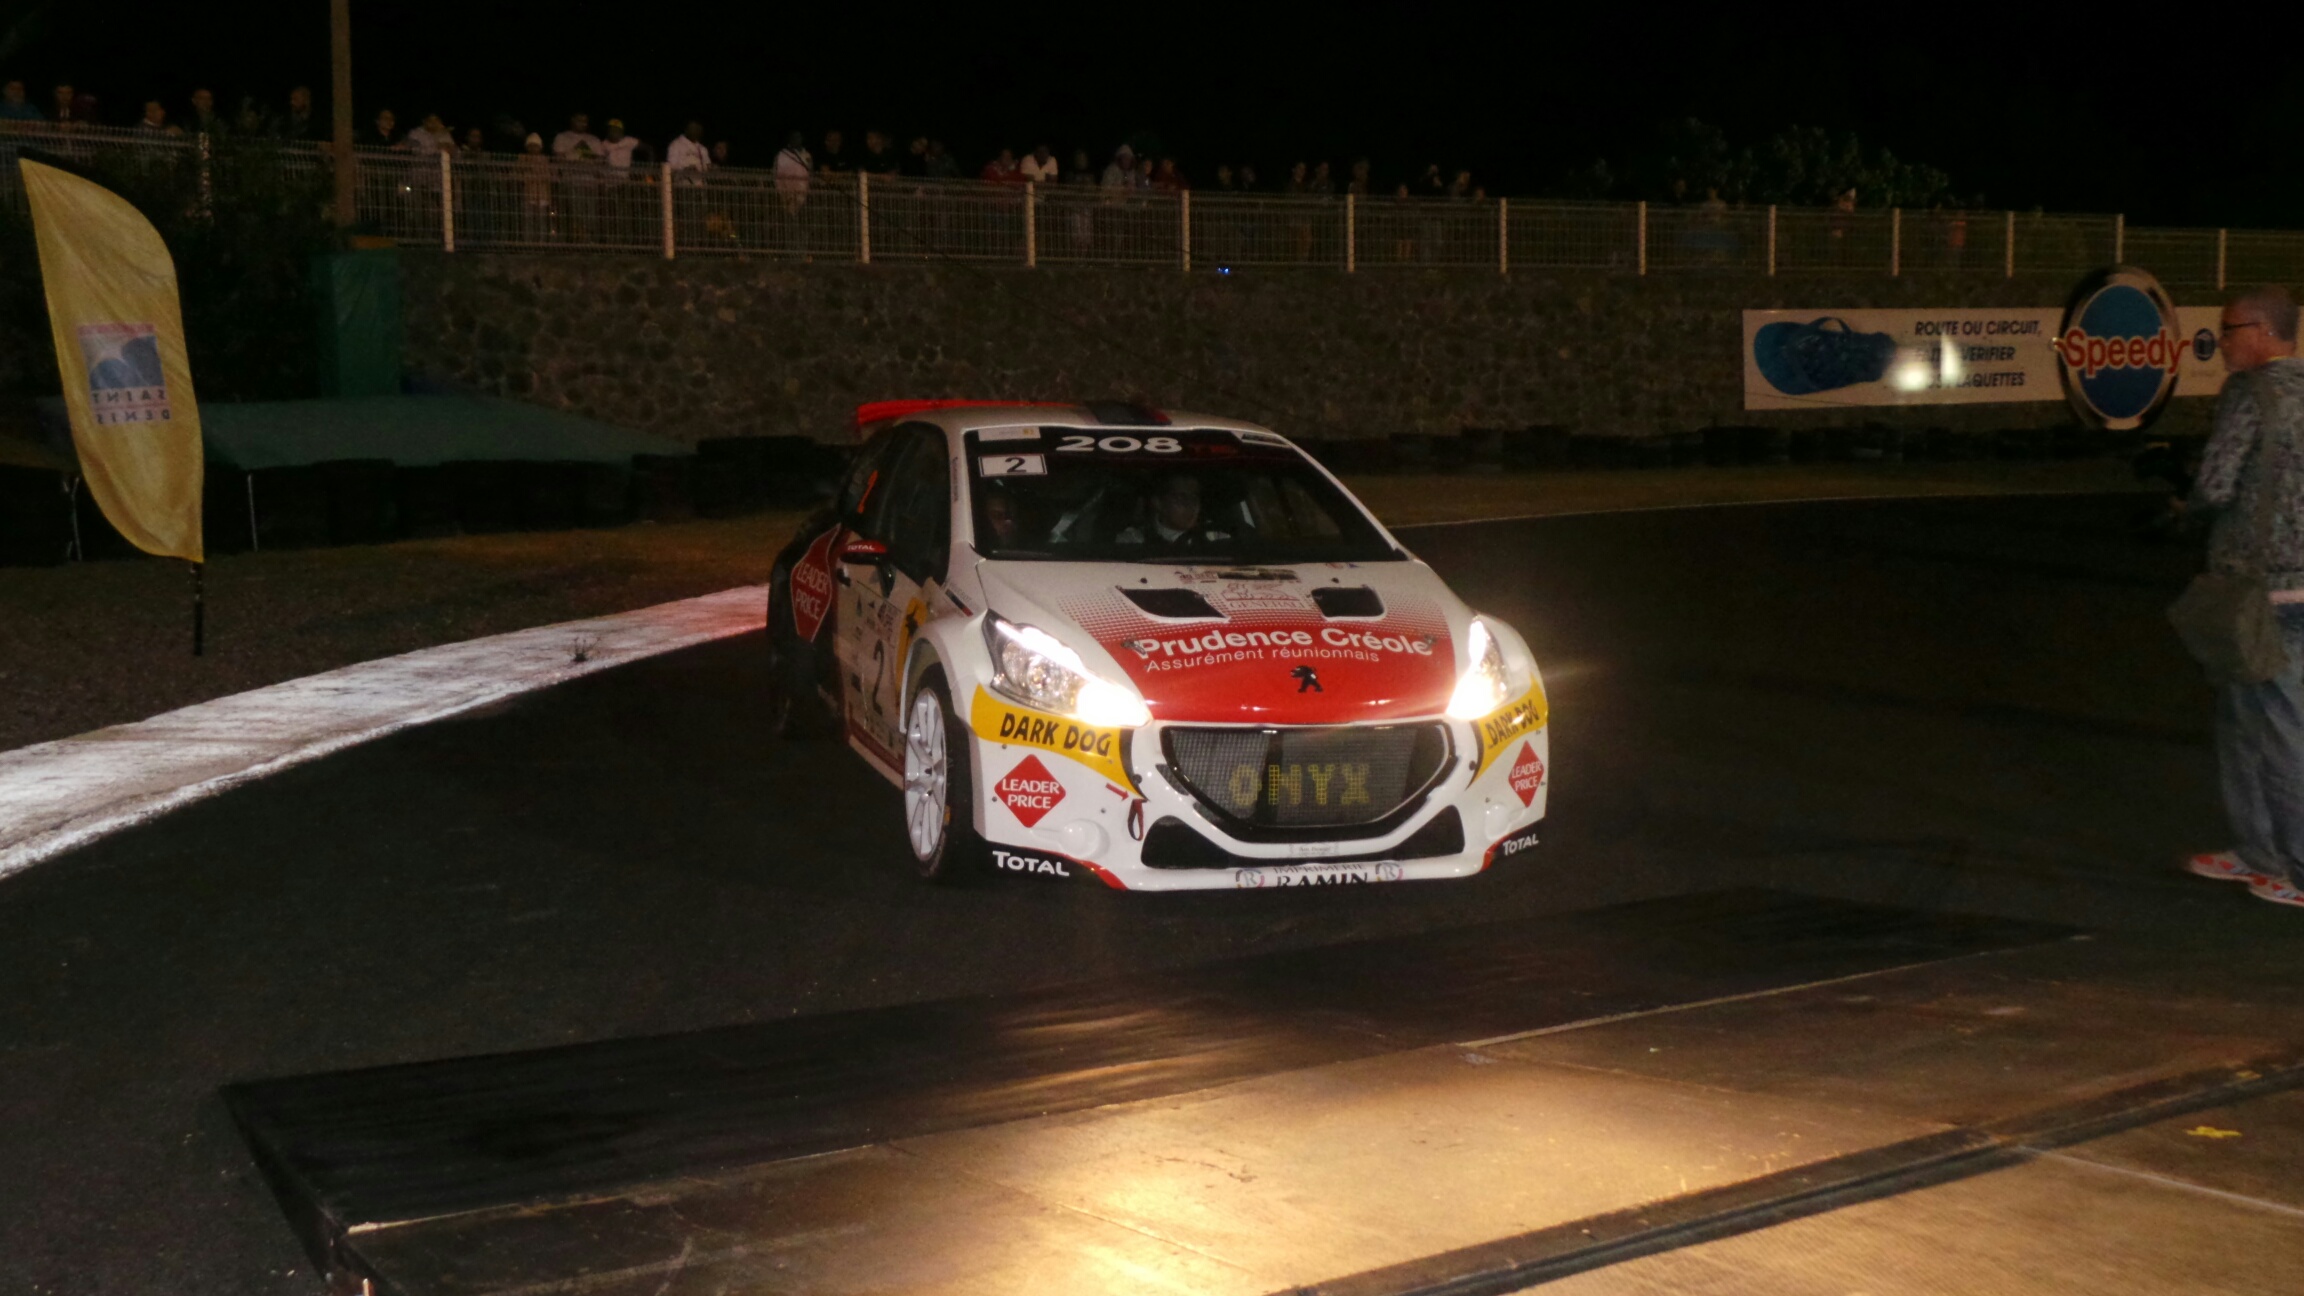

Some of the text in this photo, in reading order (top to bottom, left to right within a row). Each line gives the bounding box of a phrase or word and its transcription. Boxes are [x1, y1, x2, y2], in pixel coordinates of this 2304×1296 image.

[1915, 320, 2042, 337] ROUTE OU CIRCUIT,
[2054, 328, 2190, 379] Speedy
[1055, 435, 1183, 453] 208
[1005, 456, 1026, 473] 2
[796, 561, 829, 596] LEADER
[796, 588, 821, 621] PRICE
[1229, 600, 1307, 609] GENERALI
[1137, 628, 1433, 659] Prudence Créole
[1146, 646, 1380, 673] Assurément réunionnais
[872, 639, 885, 716] 2
[1485, 699, 1540, 746] DARK DOG
[999, 712, 1112, 757] DARK DOG
[1512, 761, 1542, 779] LEADER
[1001, 778, 1061, 795] LEADER
[1514, 775, 1539, 791] PRICE
[1007, 794, 1052, 809] PRICE
[1503, 833, 1539, 856] TOTAL
[992, 850, 1070, 877] TOTAL
[1273, 862, 1367, 873] IMPRIMERIE
[1276, 872, 1369, 887] RAMIN
